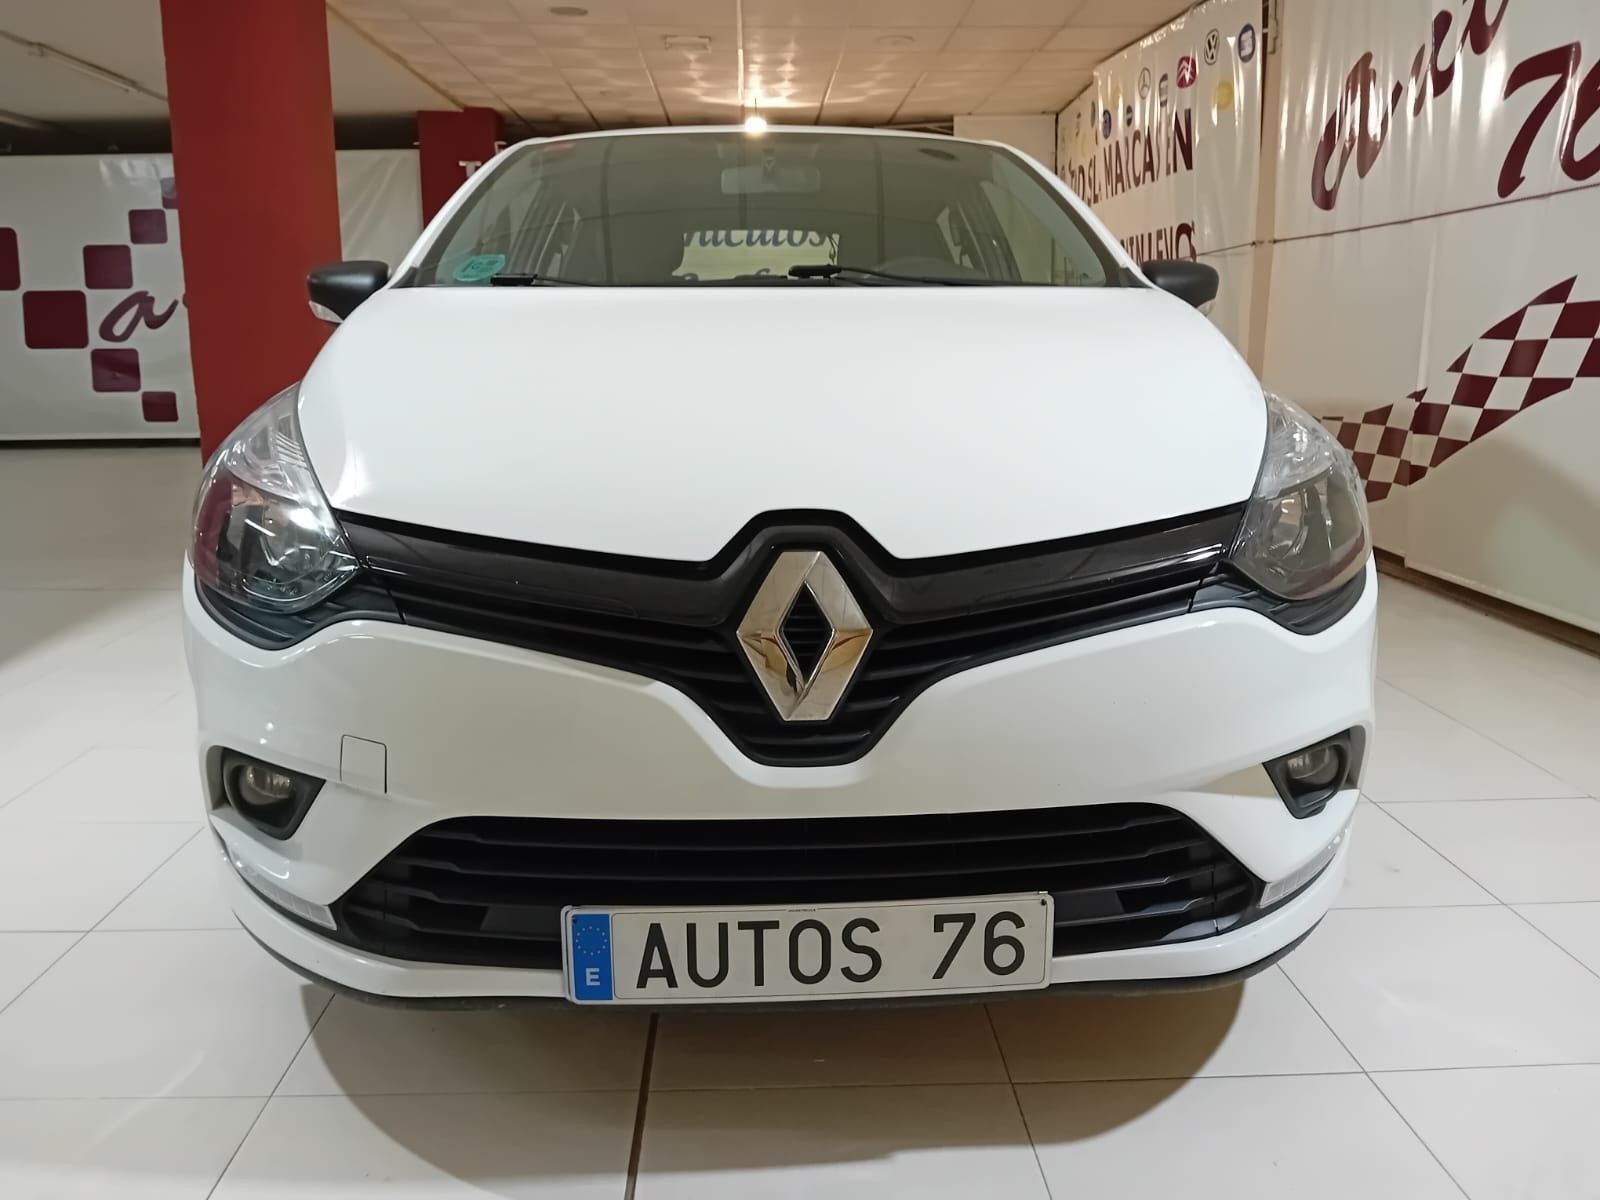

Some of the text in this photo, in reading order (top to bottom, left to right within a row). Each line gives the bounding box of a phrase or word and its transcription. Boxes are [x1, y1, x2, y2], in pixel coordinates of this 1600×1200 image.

[636, 910, 1026, 989] AUTOS 76
[585, 967, 601, 986] E
